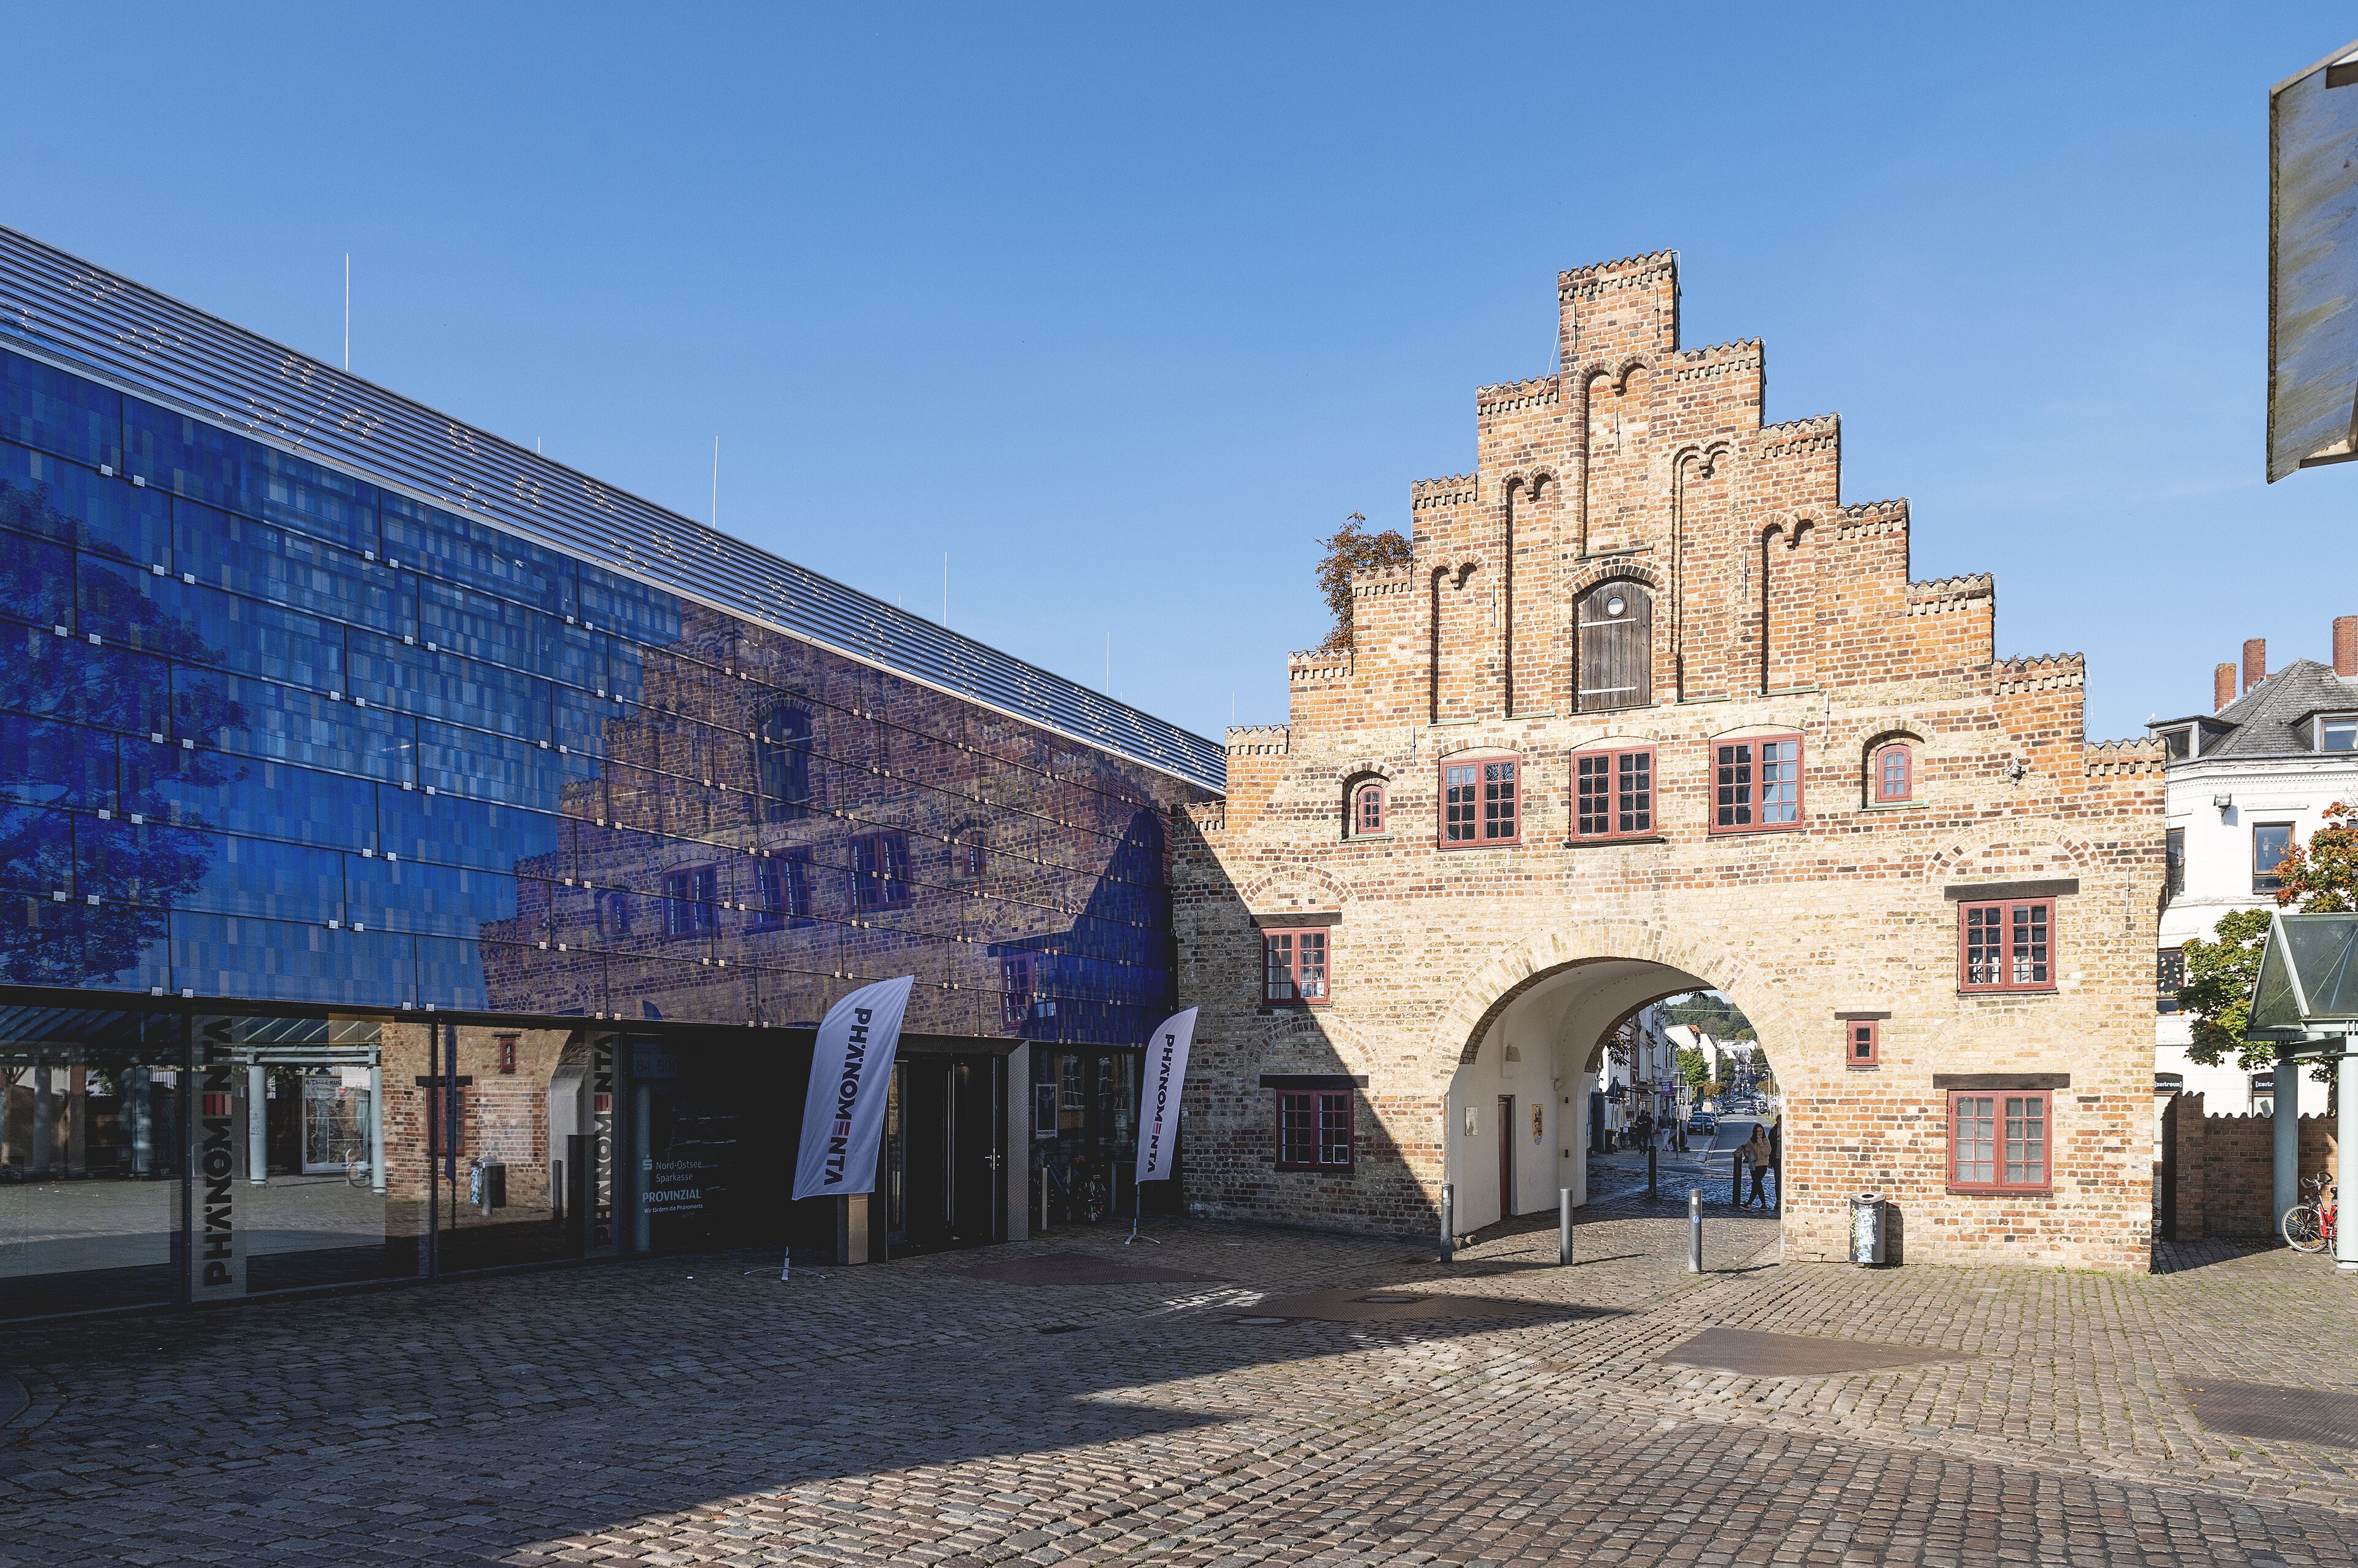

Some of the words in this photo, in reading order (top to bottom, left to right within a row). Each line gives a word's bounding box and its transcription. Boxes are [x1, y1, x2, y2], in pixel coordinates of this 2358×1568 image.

[823, 1007, 872, 1186] PHÄNOMENTA
[1146, 1033, 1175, 1173] PHÄNOMENTA
[204, 1017, 233, 1286] PHÄNOMENTA
[656, 1160, 702, 1170] Nord-Ostsee
[656, 1172, 693, 1184] Sparkasse
[642, 1189, 702, 1203] PROVINZIAL
